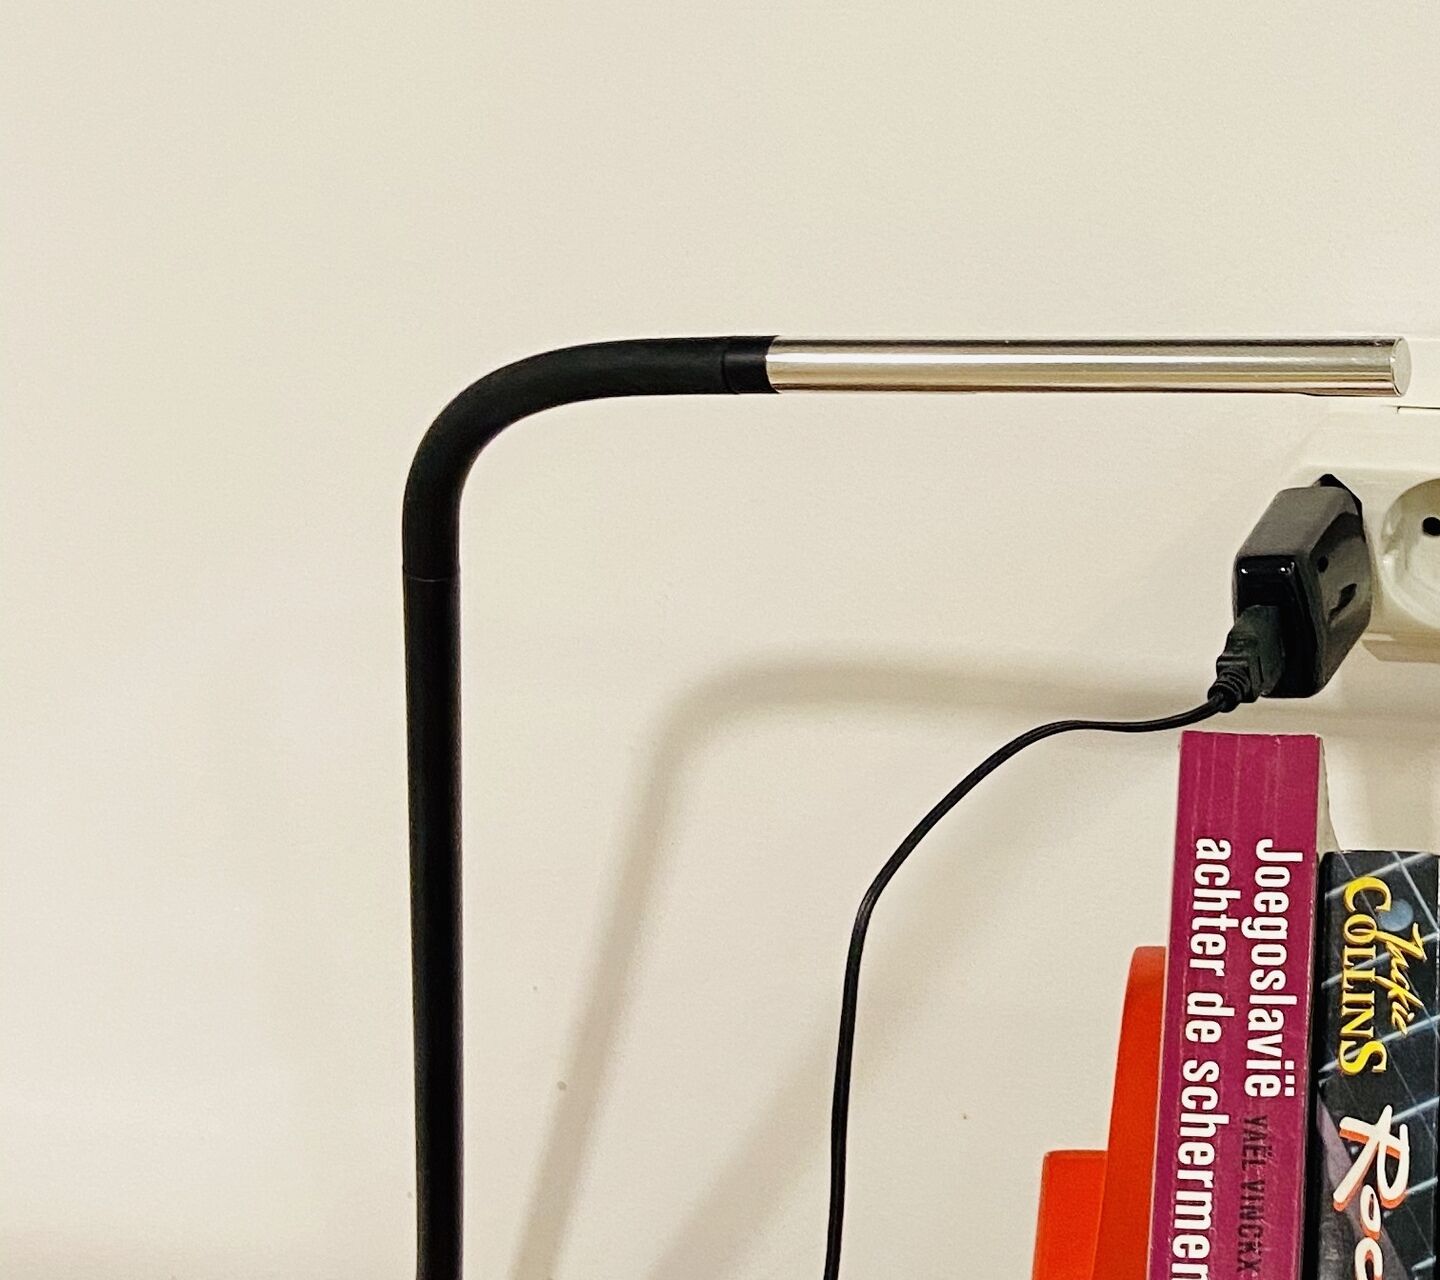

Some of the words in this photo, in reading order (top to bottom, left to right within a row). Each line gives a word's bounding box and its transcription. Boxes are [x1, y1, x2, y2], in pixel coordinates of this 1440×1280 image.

[1188, 837, 1242, 976] achter
[1242, 837, 1304, 1098] Joegoslavië
[1337, 875, 1392, 1077] COLLINS
[1184, 992, 1236, 1045] de
[1376, 923, 1427, 1037] Jackie
